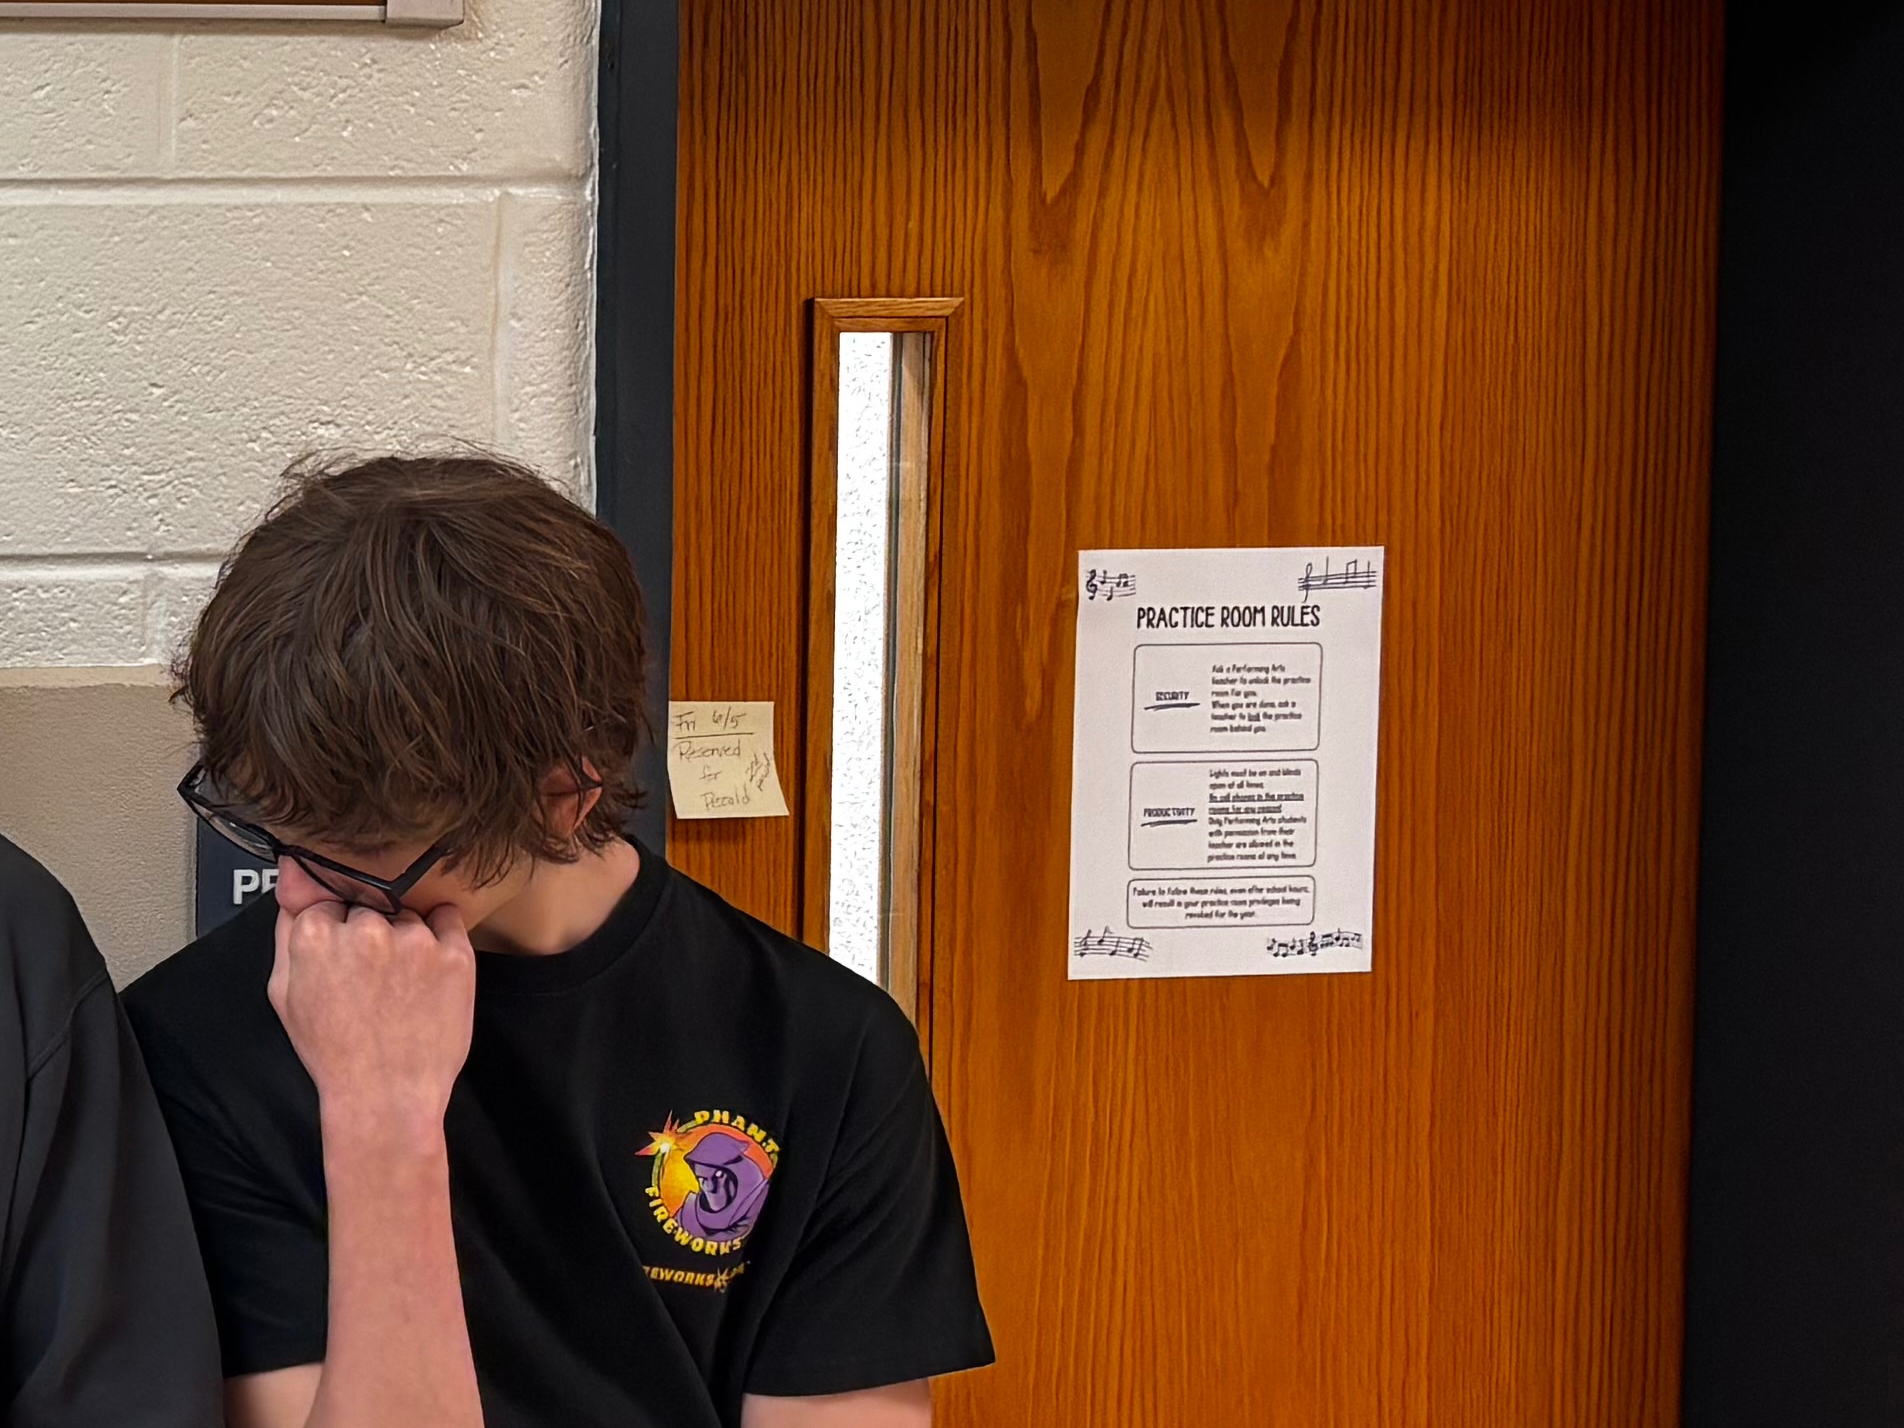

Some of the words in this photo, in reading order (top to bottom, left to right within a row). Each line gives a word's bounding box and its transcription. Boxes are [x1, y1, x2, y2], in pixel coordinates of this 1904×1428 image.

[1137, 606, 1215, 629] PRACTICE
[1220, 606, 1266, 628] ROOM
[1270, 605, 1321, 627] RULES
[645, 1186, 742, 1256] FIREWORKS
